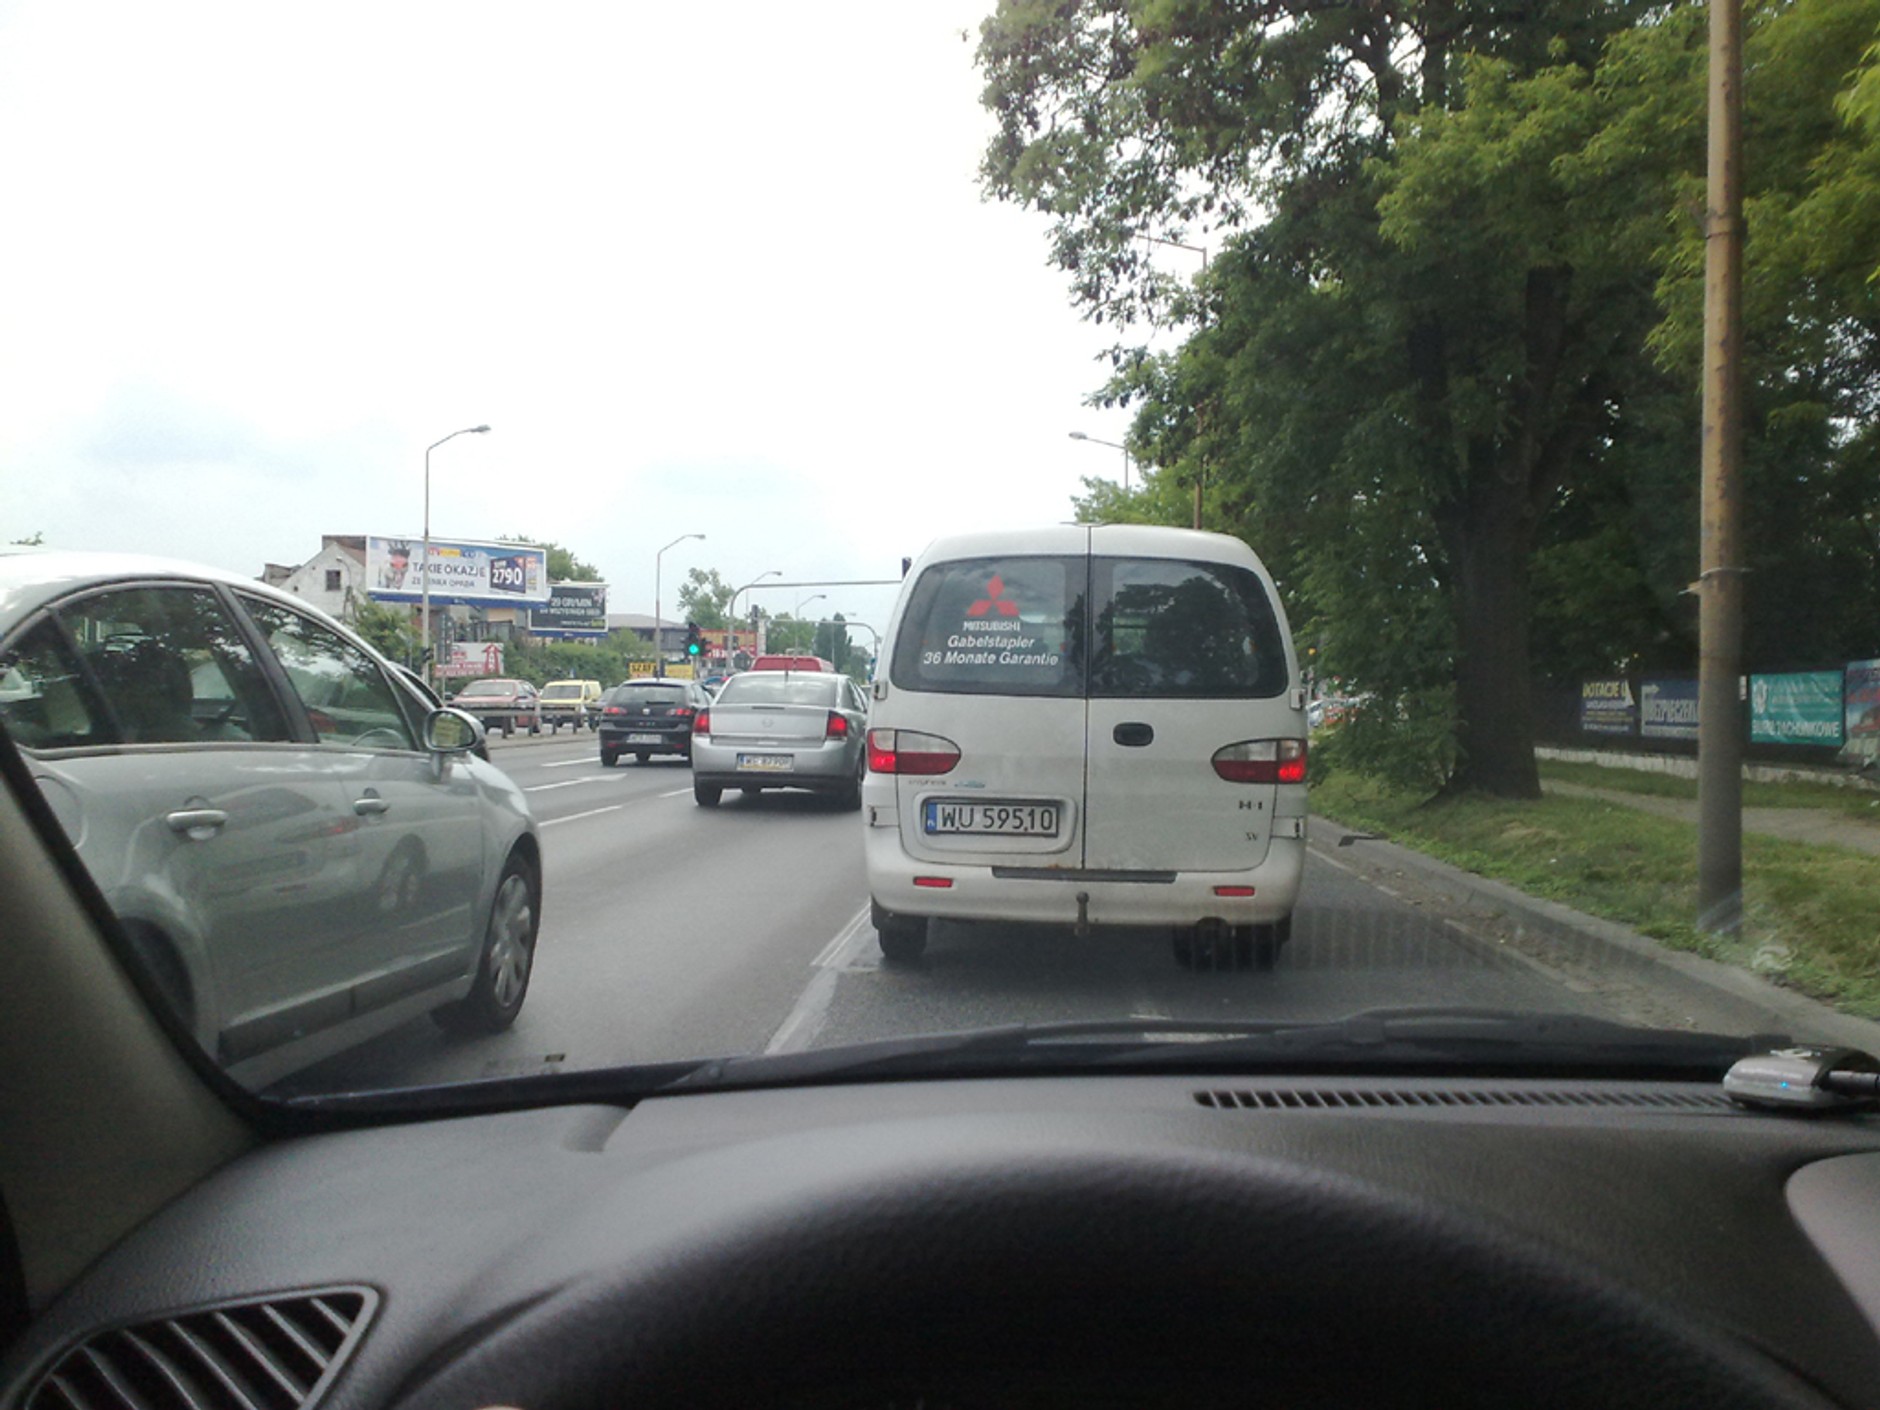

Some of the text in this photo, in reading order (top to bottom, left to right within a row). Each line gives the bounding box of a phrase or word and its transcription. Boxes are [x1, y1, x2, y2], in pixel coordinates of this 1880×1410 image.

[492, 568, 523, 586] 2790
[962, 620, 1021, 632] MITSUBISHI
[947, 635, 1036, 651] Gabelstapler
[923, 651, 1059, 666] 36 Monate Garantie
[942, 807, 1054, 831] WU 59510
